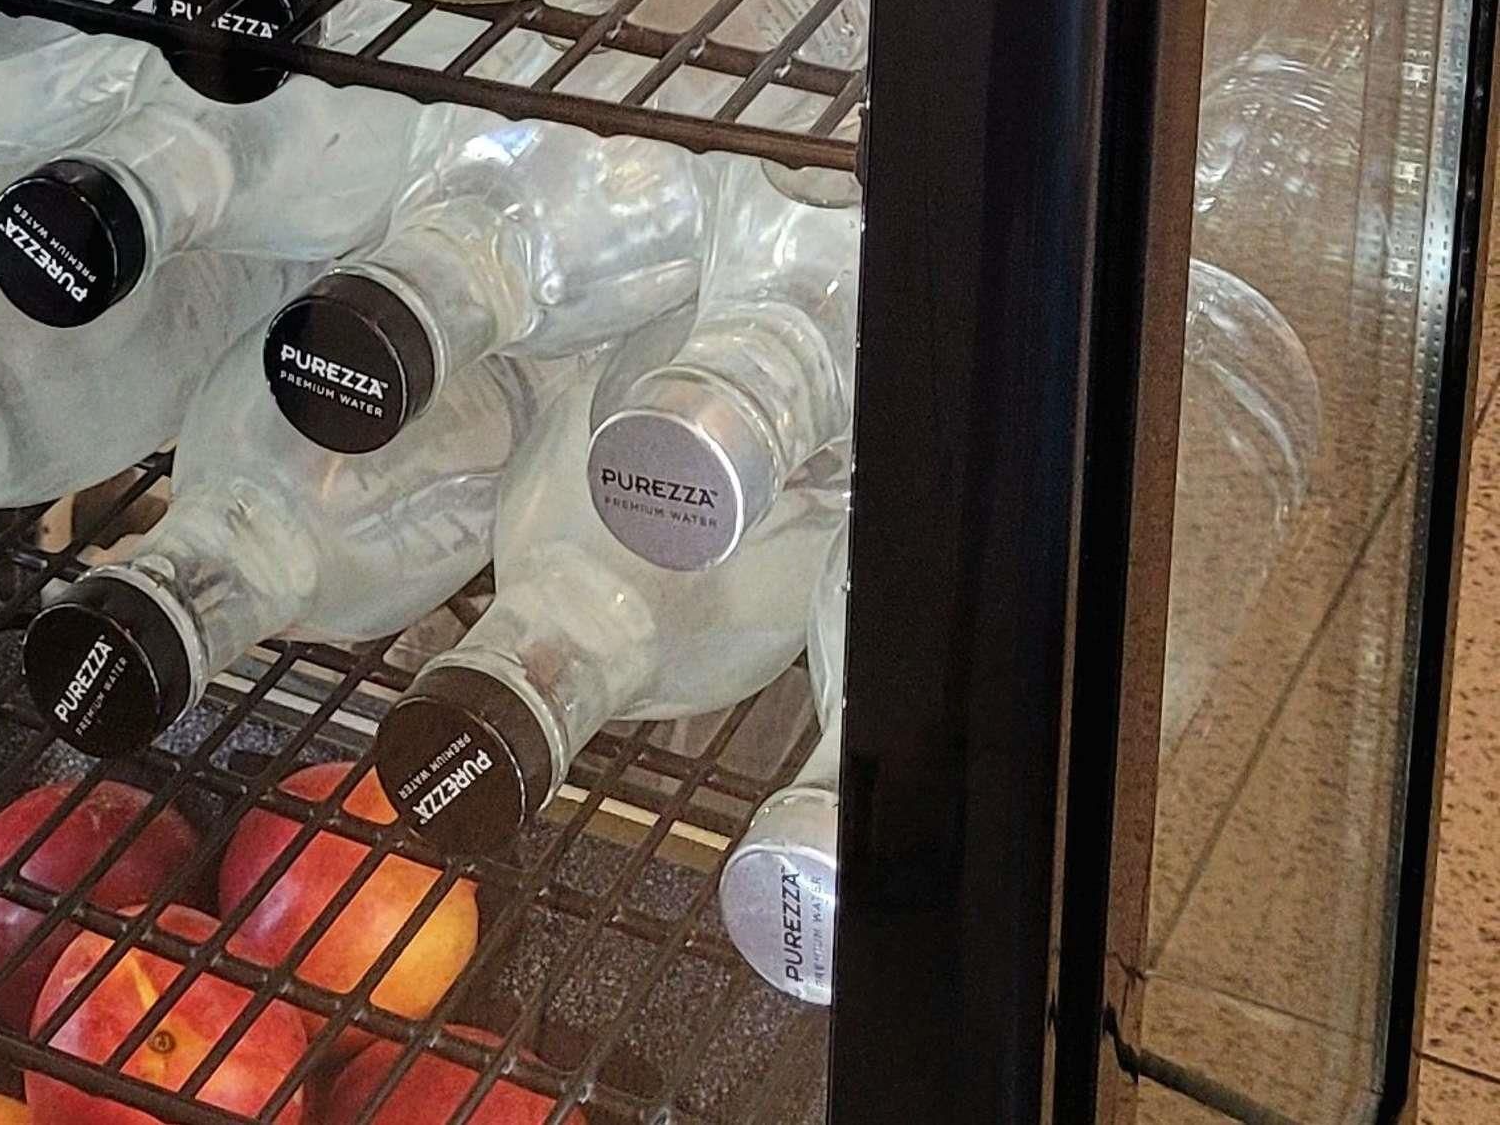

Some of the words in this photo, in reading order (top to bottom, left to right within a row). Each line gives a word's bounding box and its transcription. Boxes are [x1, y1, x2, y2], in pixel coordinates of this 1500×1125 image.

[170, 0, 274, 39] PUEZZA
[13, 203, 49, 239] WATER
[2, 216, 89, 302] PUREZZA
[50, 237, 97, 283] PREMIUM
[280, 344, 385, 400] PUREZZA
[280, 370, 335, 400] PREMIUM
[340, 393, 384, 418] WATER
[601, 468, 716, 510] PUREZZA
[604, 496, 665, 517] PREMIUM
[670, 510, 718, 528] WATER
[54, 640, 113, 723] PUREZZA
[75, 692, 105, 737] PREMIUM
[103, 656, 128, 691] WATER
[429, 732, 472, 772] PREMIUM
[398, 769, 431, 800] WATER
[412, 749, 493, 820] PUREZZA
[782, 871, 804, 982] PUREZZA
